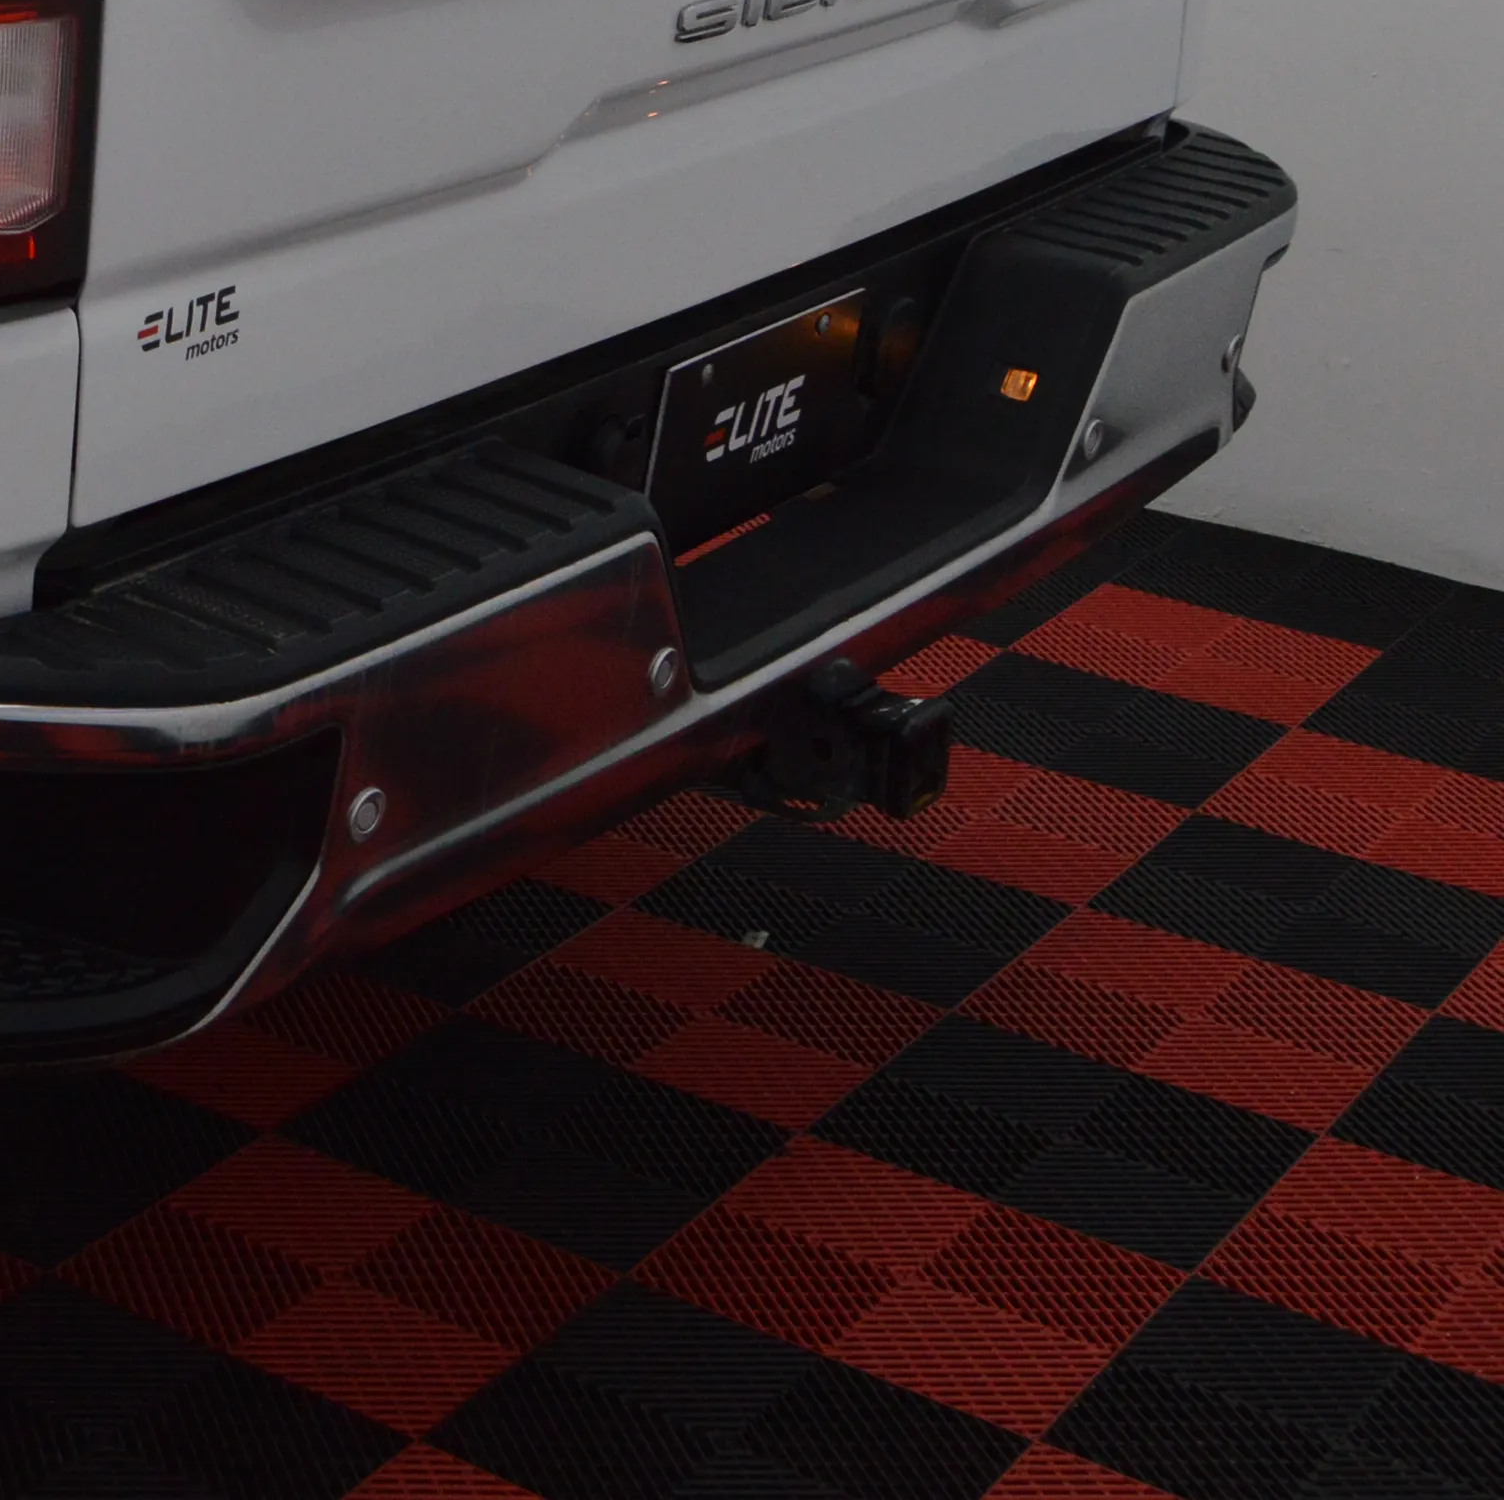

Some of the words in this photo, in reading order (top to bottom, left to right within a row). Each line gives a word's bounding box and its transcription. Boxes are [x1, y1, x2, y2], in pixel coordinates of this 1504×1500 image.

[137, 284, 240, 352] ELITE
[184, 328, 240, 361] motors
[703, 374, 806, 463] ELITE
[749, 428, 796, 464] motors
